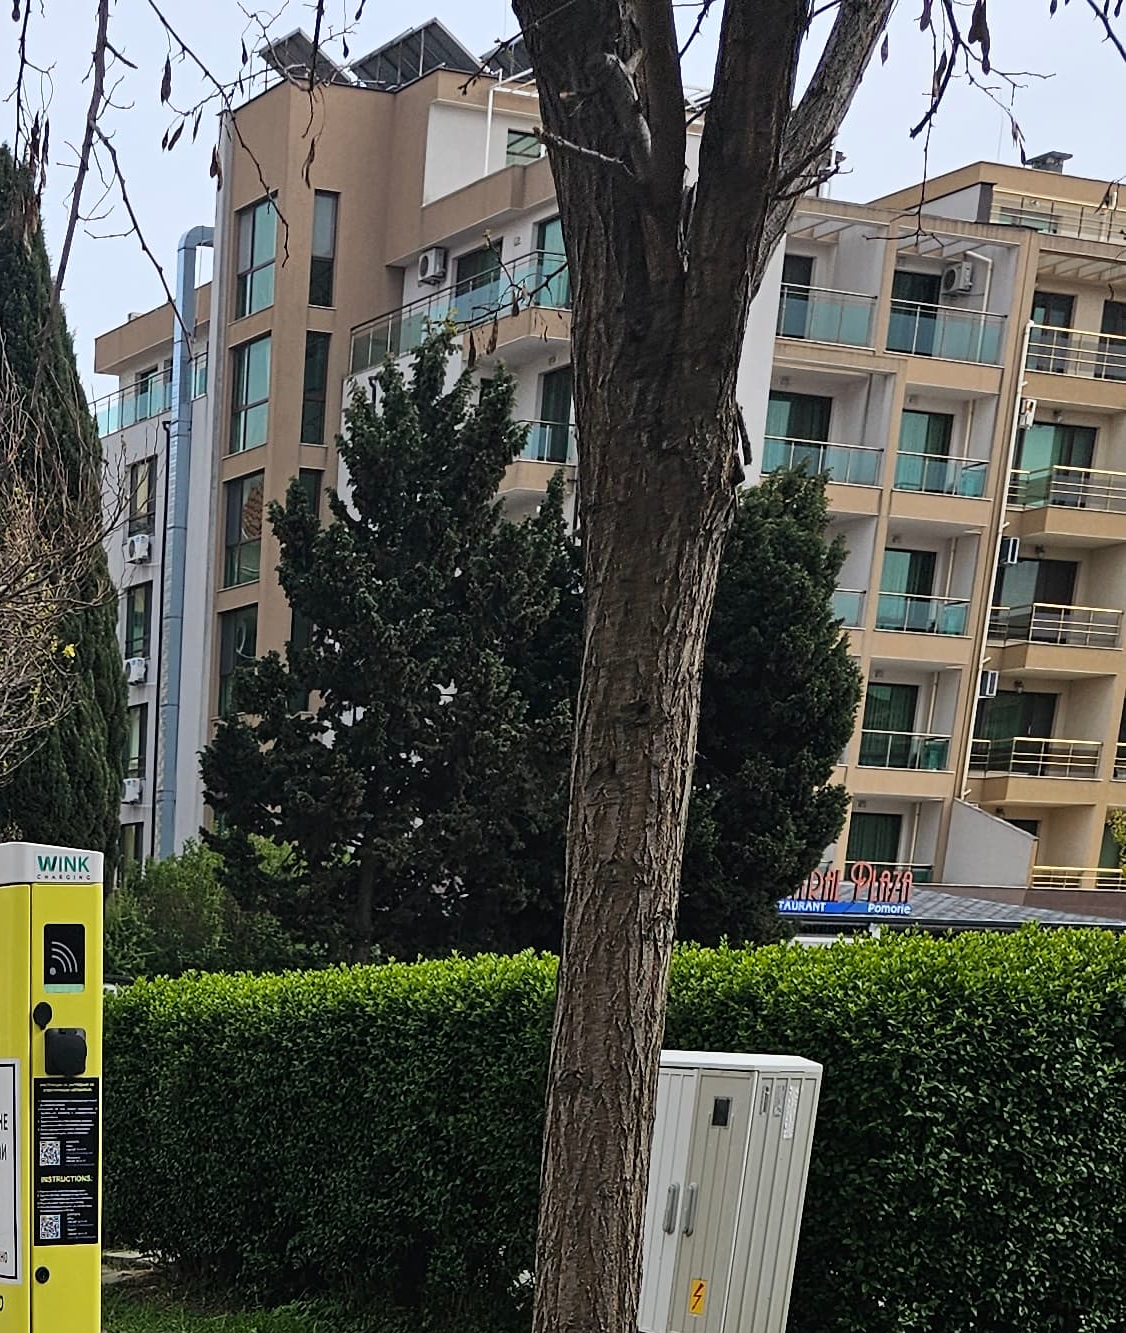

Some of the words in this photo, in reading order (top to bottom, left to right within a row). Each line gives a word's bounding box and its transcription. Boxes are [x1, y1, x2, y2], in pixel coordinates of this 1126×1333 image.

[37, 855, 90, 873] WINK
[778, 901, 826, 912] TAURANT
[868, 903, 911, 915] Pomorie
